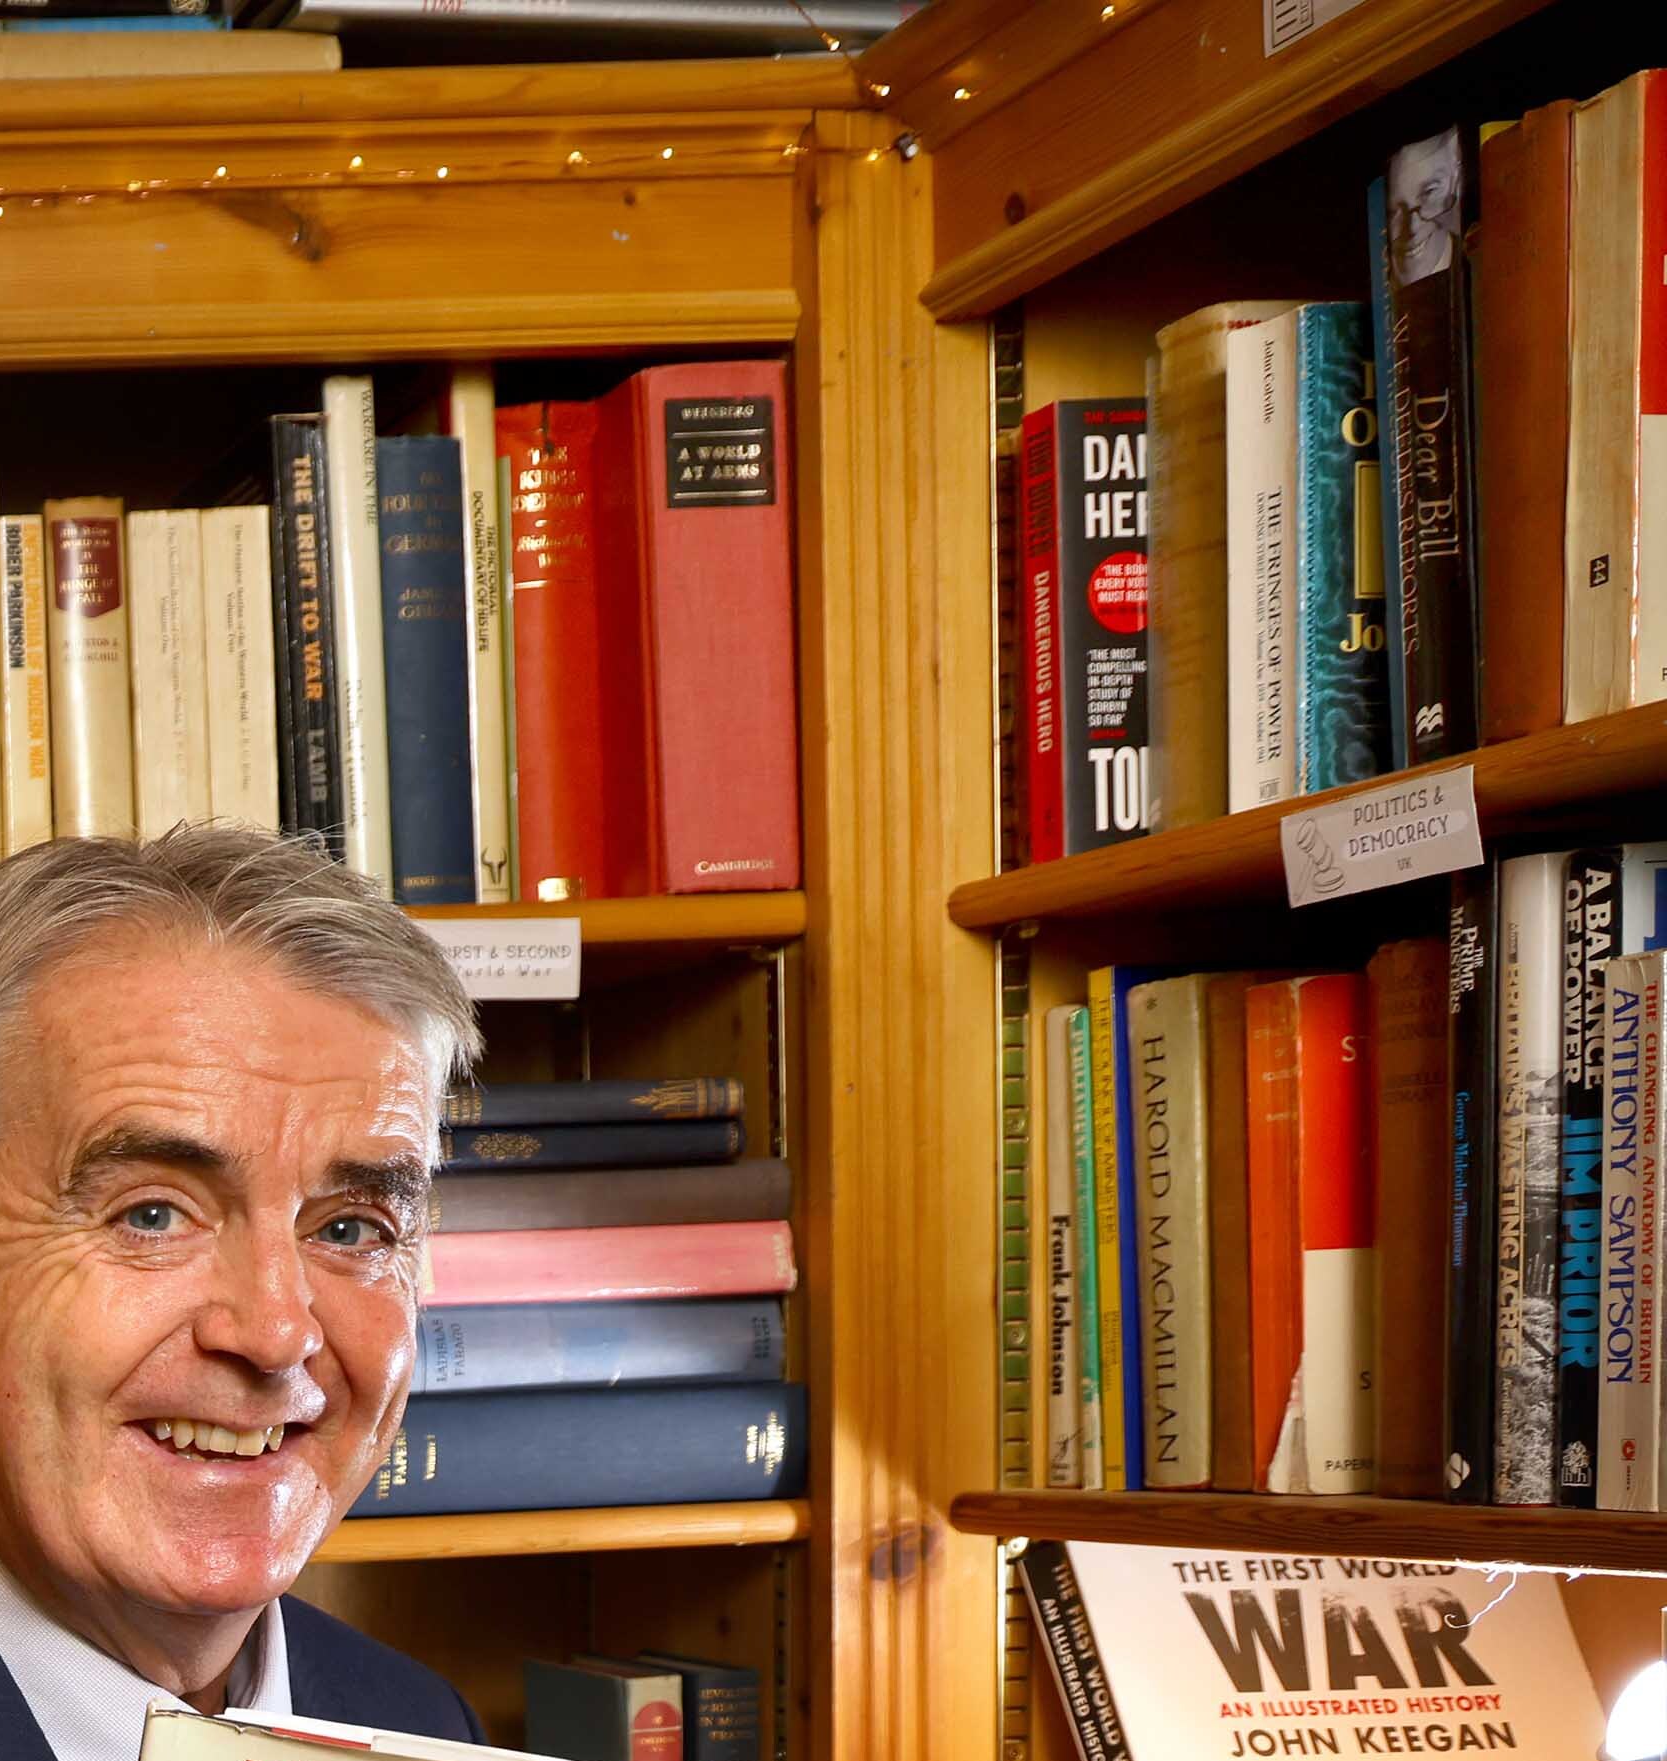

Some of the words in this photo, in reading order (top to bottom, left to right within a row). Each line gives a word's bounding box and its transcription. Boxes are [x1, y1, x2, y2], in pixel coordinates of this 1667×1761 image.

[1263, 339, 1274, 367] John
[1263, 369, 1276, 425] Colville
[1415, 391, 1450, 487] Dear
[289, 453, 313, 504] THE
[1267, 487, 1284, 523] THE
[295, 512, 317, 589] DRIFT
[1417, 491, 1460, 562] Bill
[300, 599, 319, 633] TO
[1267, 533, 1284, 639] FRINGES
[1034, 570, 1052, 694] DANGEROUS
[1268, 646, 1283, 673] OF
[302, 645, 325, 701] WAR
[1036, 698, 1054, 754] HERO
[1266, 683, 1284, 761] POWER
[1348, 817, 1449, 858] DEMOCRACY
[1354, 794, 1428, 826] POLITICS
[1432, 787, 1446, 806] &
[1567, 882, 1582, 932] OF
[1586, 868, 1611, 888] A
[1565, 938, 1585, 1086] POWER
[1583, 894, 1611, 1092] BALANCE
[1607, 988, 1640, 1178] ANTHONY
[1141, 1035, 1173, 1199] HAROLD
[1049, 1215, 1073, 1279] Frank
[1559, 1208, 1601, 1370] PRIOR
[1607, 1196, 1636, 1386] SAMPSON
[1051, 1283, 1075, 1396] Johnson
[1149, 1214, 1179, 1466] MACMILLAN
[1172, 1562, 1236, 1585] THE
[1246, 1558, 1326, 1582] FIRST
[1182, 1588, 1497, 1694] WAR
[1220, 1702, 1254, 1718] AN
[1262, 1699, 1400, 1718] ILLUSTRATED
[1408, 1694, 1504, 1714] HISTORY
[1230, 1728, 1340, 1759] JOHN
[1359, 1723, 1517, 1755] KEEGAN
